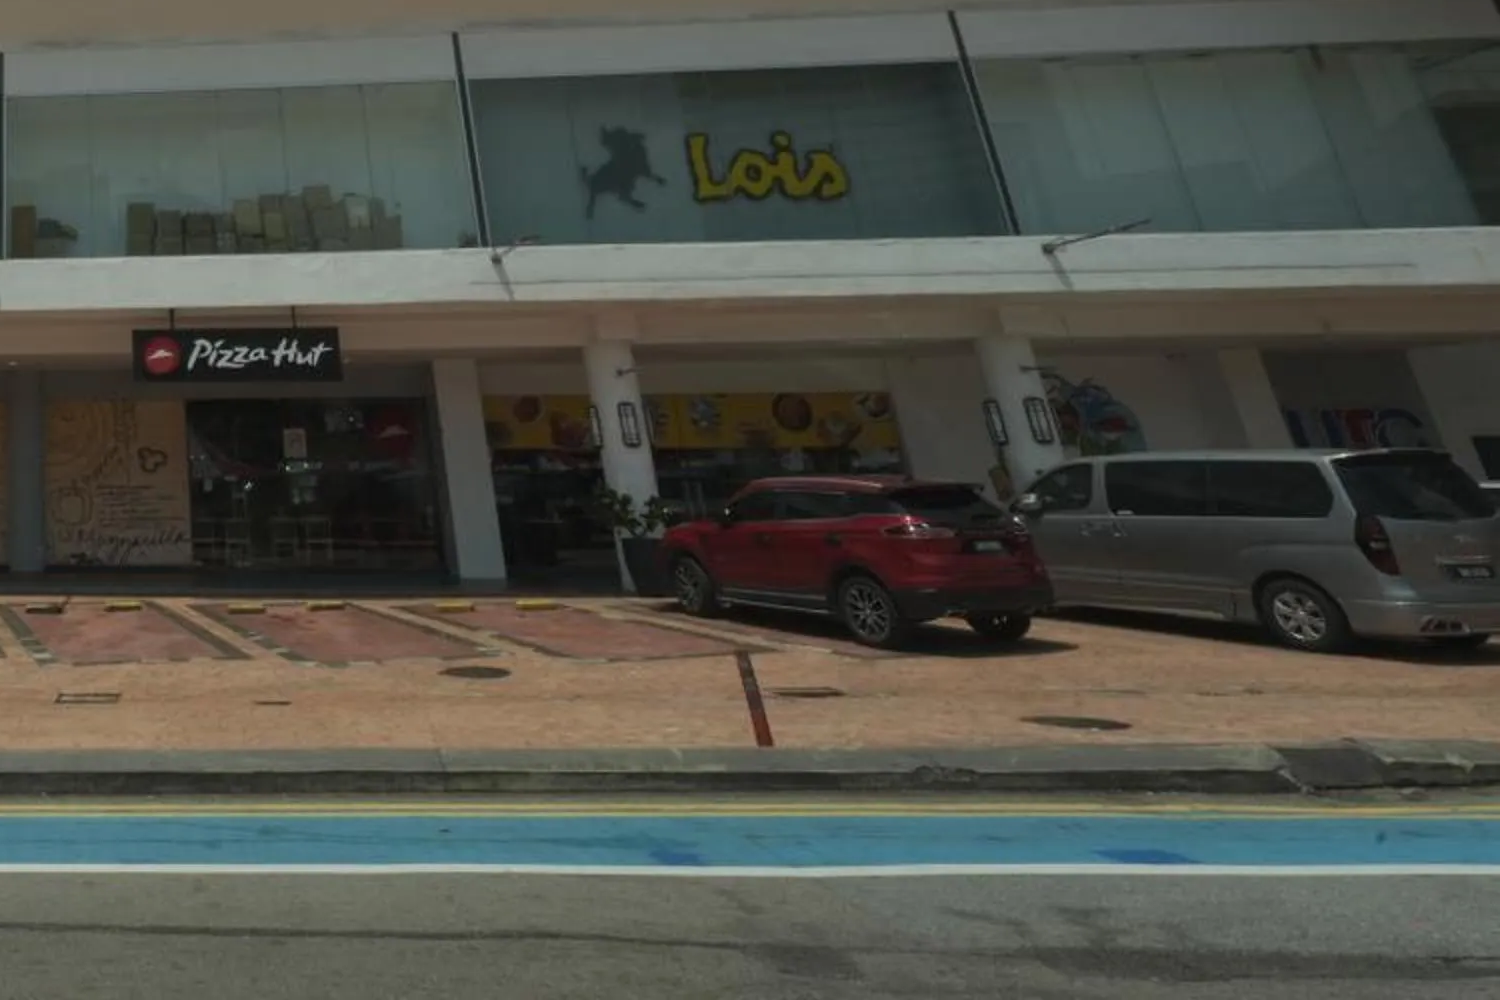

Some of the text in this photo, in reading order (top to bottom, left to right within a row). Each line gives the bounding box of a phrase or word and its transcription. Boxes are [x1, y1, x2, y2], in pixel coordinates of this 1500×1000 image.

[686, 130, 851, 203] Lois
[186, 336, 335, 373] Pizza Hut
